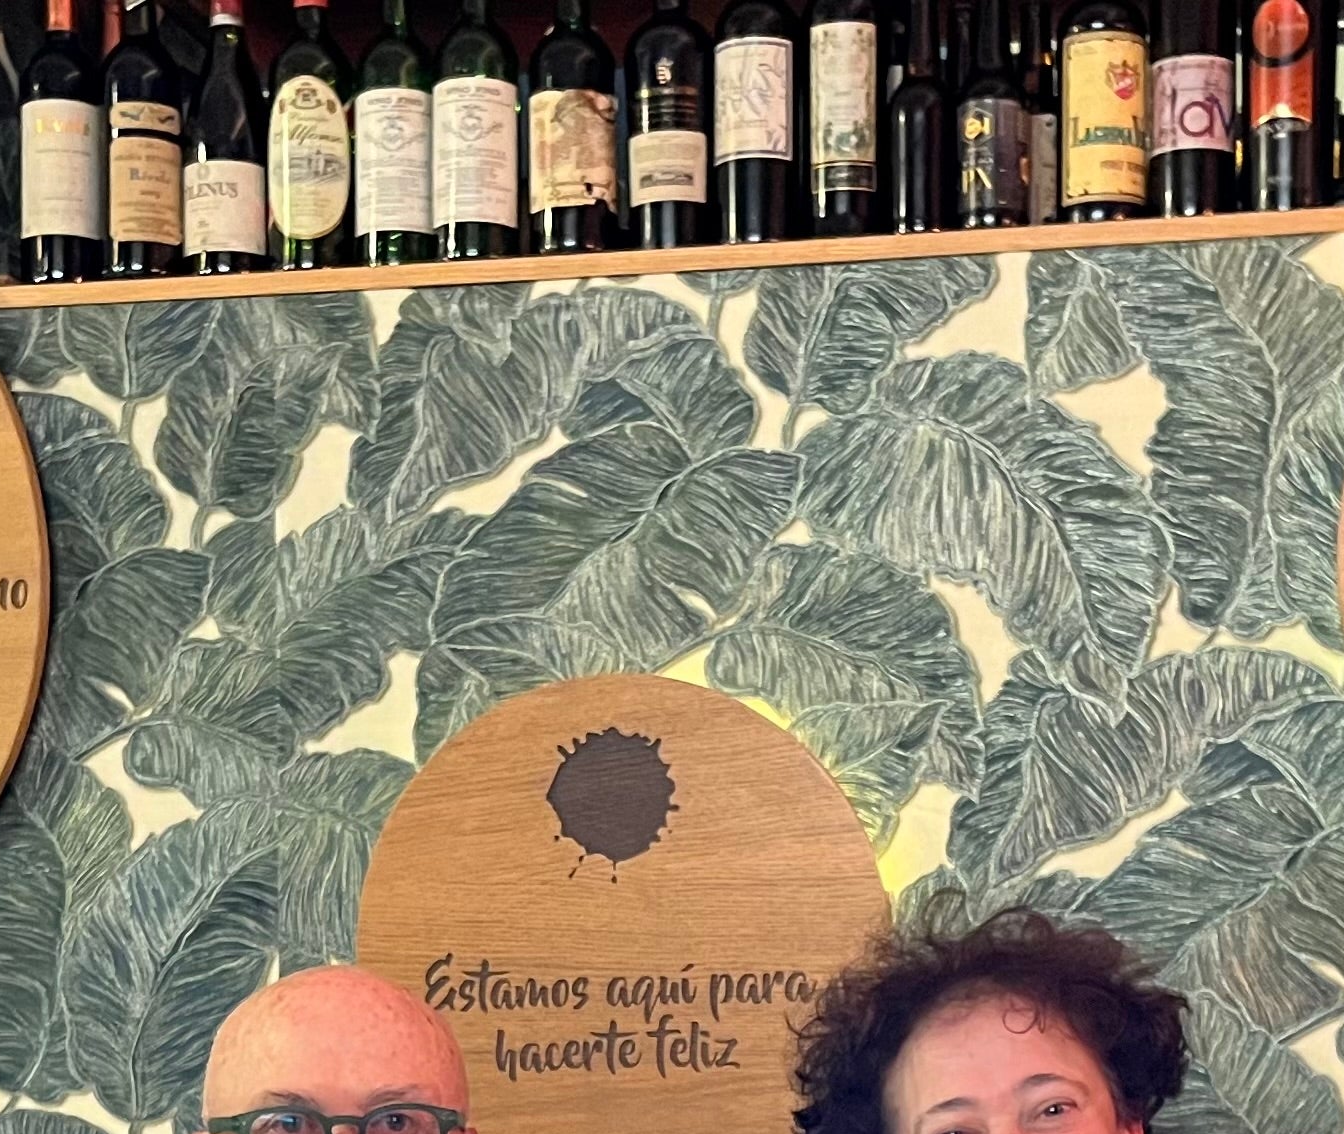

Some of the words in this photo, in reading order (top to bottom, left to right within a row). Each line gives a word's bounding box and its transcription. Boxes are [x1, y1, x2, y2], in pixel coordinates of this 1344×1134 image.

[423, 952, 590, 1014] Estamos
[605, 962, 698, 1024] aquí
[709, 970, 818, 1022] para
[495, 1019, 643, 1083] hacerte
[644, 1013, 742, 1080] feliz
